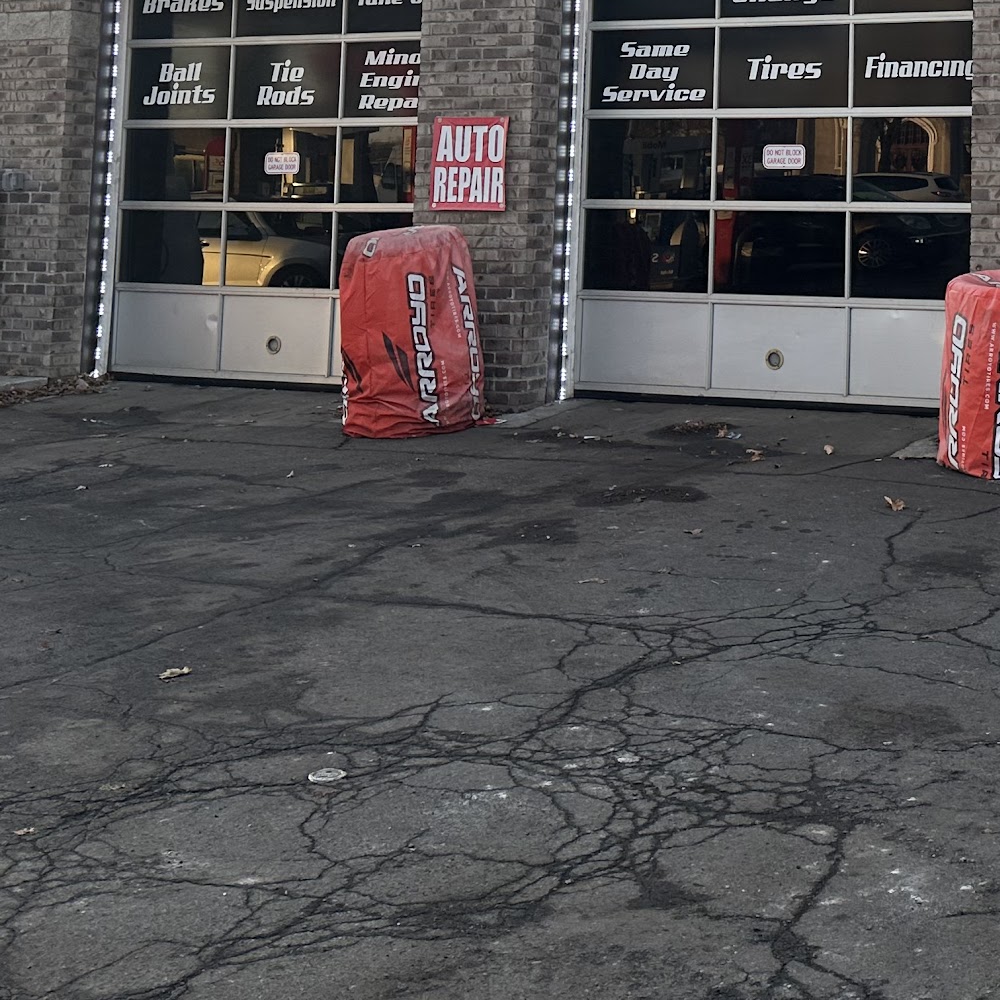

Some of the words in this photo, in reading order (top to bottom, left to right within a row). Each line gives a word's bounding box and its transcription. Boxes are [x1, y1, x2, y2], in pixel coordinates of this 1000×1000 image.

[364, 47, 420, 65] Mino
[619, 41, 690, 59] Same
[158, 62, 203, 84] Ball
[271, 59, 304, 84] Tie
[629, 63, 679, 82] Day
[746, 54, 823, 81] Tires
[143, 83, 216, 106] Joints
[256, 85, 315, 107] Rods
[358, 94, 418, 111] Repa
[602, 83, 707, 103] Service
[436, 125, 504, 163] AUTO
[434, 166, 504, 203] REPAIR
[407, 273, 439, 426] ARROYO
[452, 266, 481, 420] ARROYO
[963, 324, 975, 385] TIRES
[949, 313, 967, 469] RROYO
